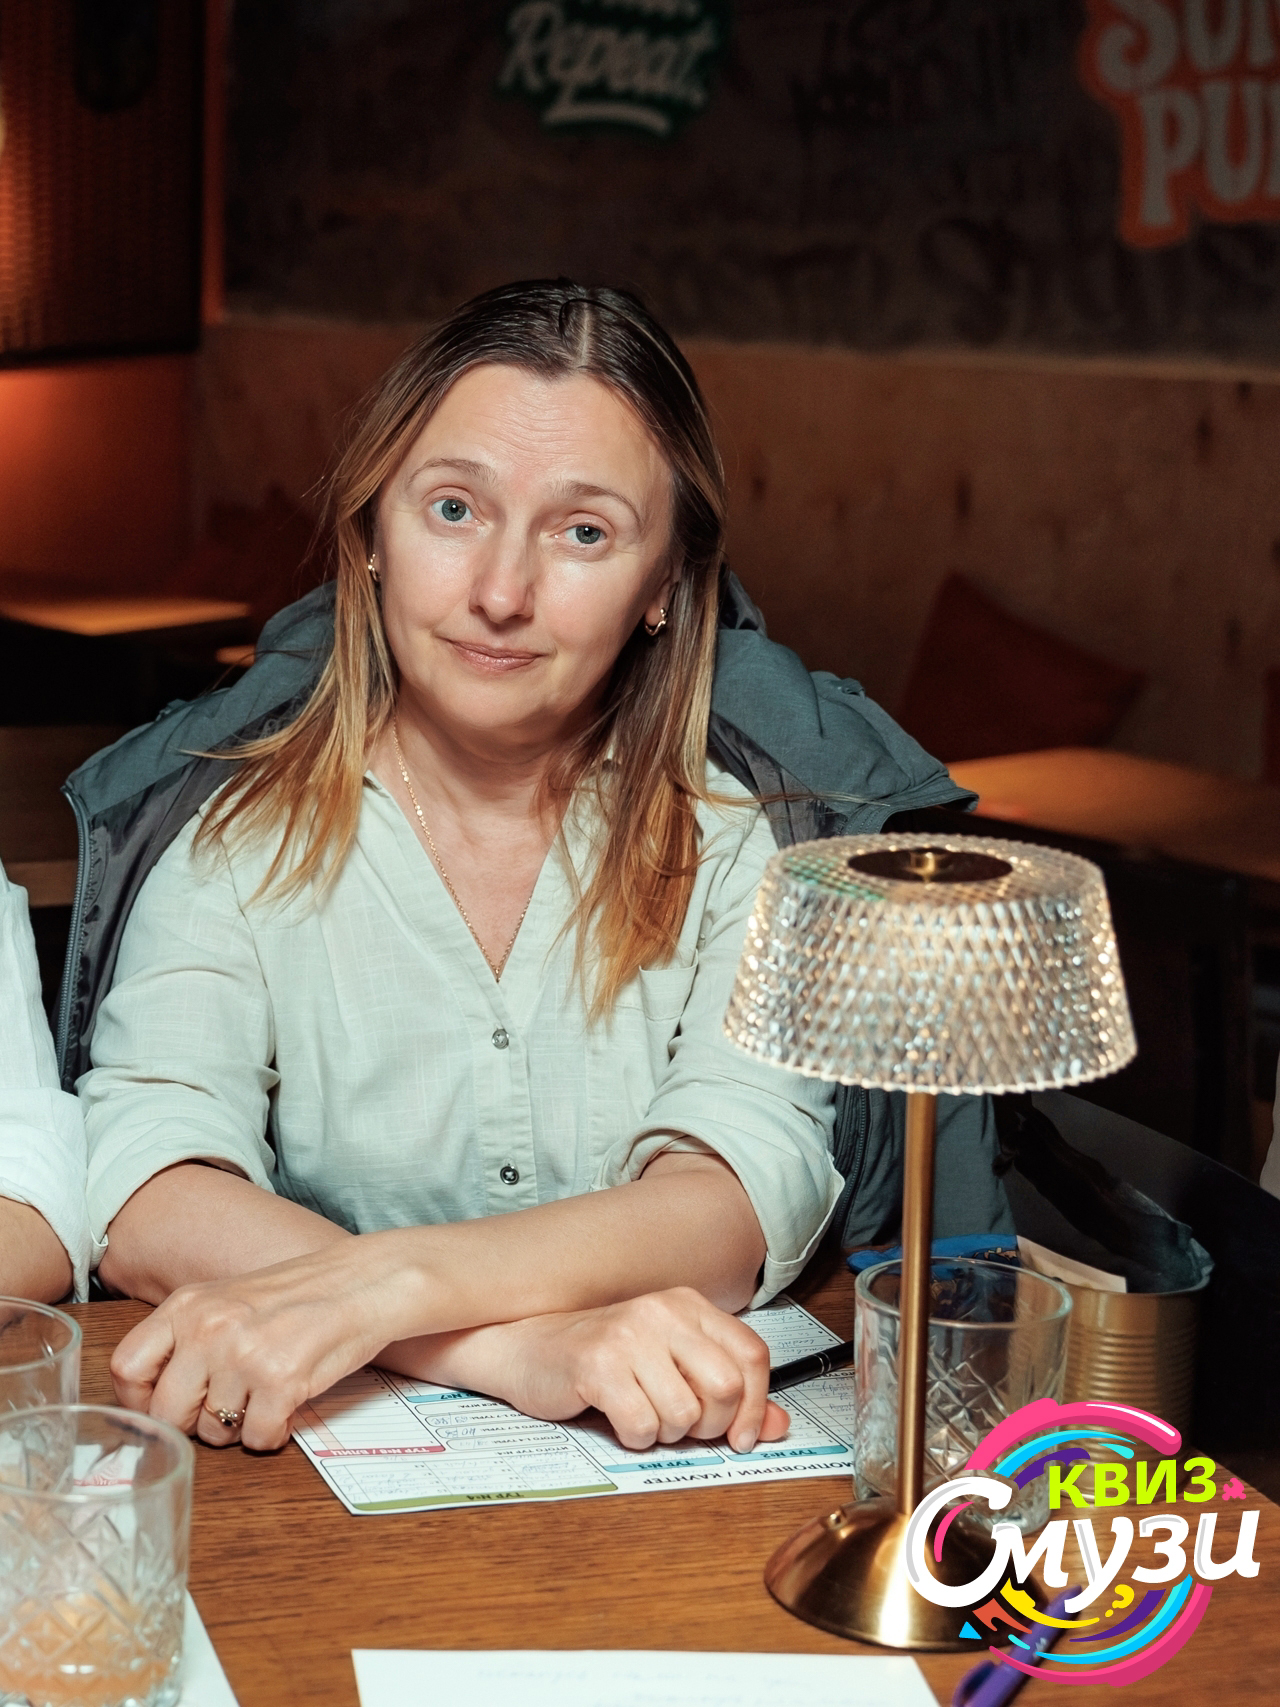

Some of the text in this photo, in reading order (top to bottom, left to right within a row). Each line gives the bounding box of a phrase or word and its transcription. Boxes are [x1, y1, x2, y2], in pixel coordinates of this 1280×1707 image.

[1138, 80, 1280, 229] PU
[666, 1459, 695, 1467] ТУР
[642, 1473, 723, 1485] КАУНТЕР
[495, 1492, 525, 1500] ТУР
